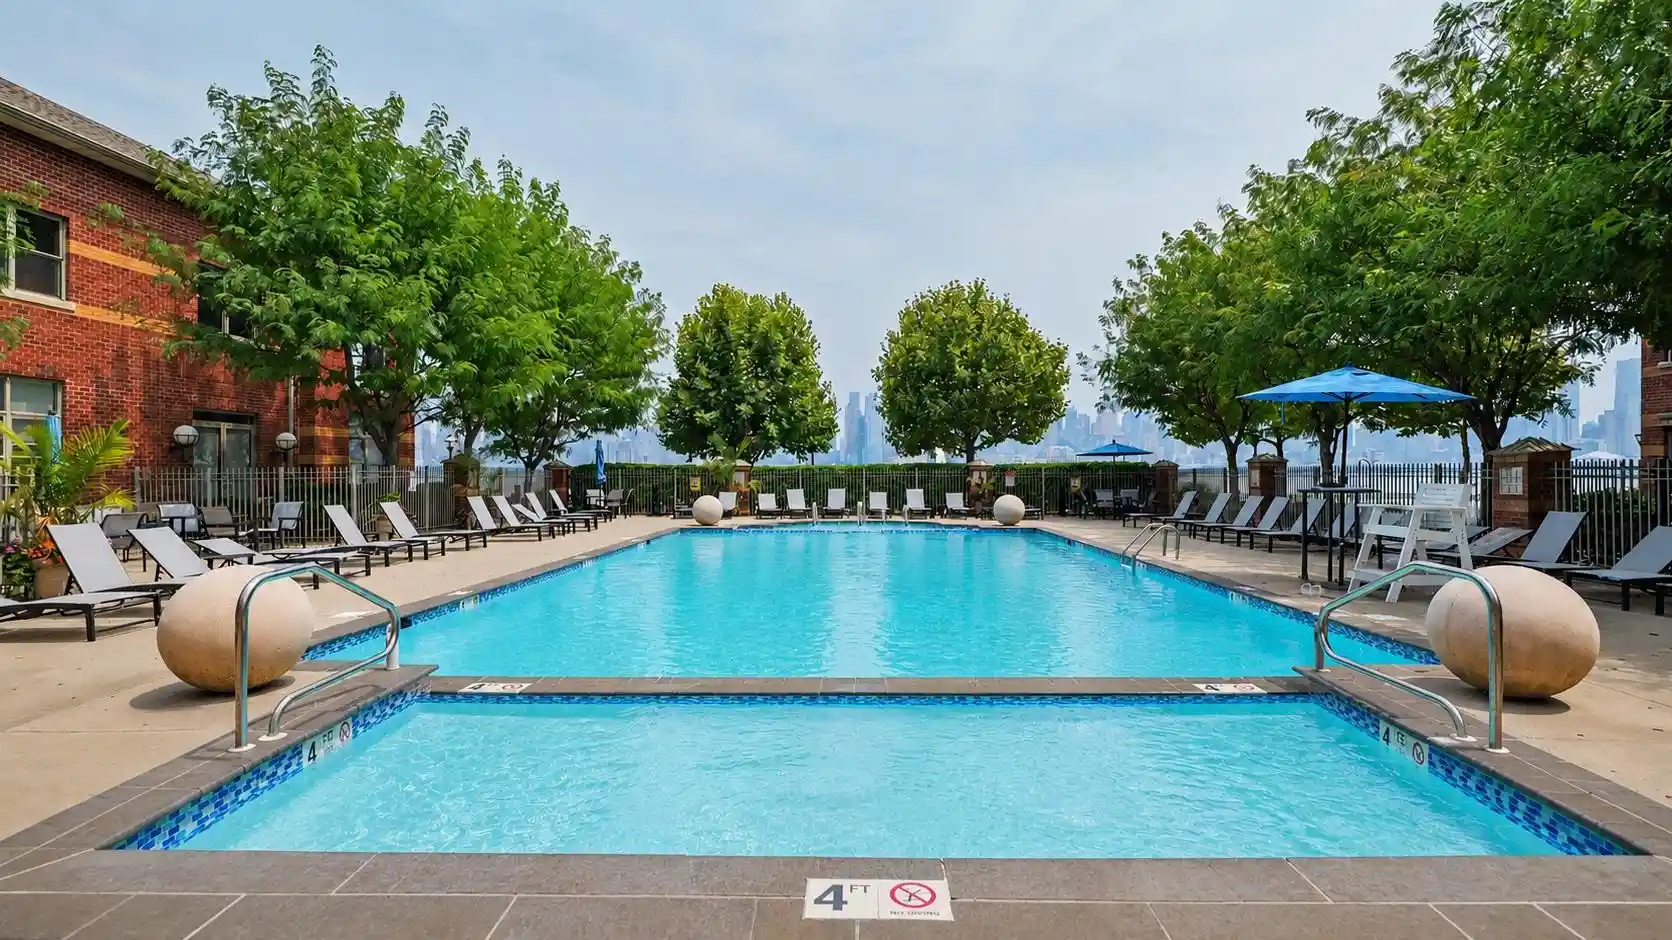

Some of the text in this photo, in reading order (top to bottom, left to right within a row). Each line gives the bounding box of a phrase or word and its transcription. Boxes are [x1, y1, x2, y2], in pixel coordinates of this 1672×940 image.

[1383, 727, 1389, 746] 4
[308, 741, 317, 762] 4
[813, 884, 871, 911] 4 FT
